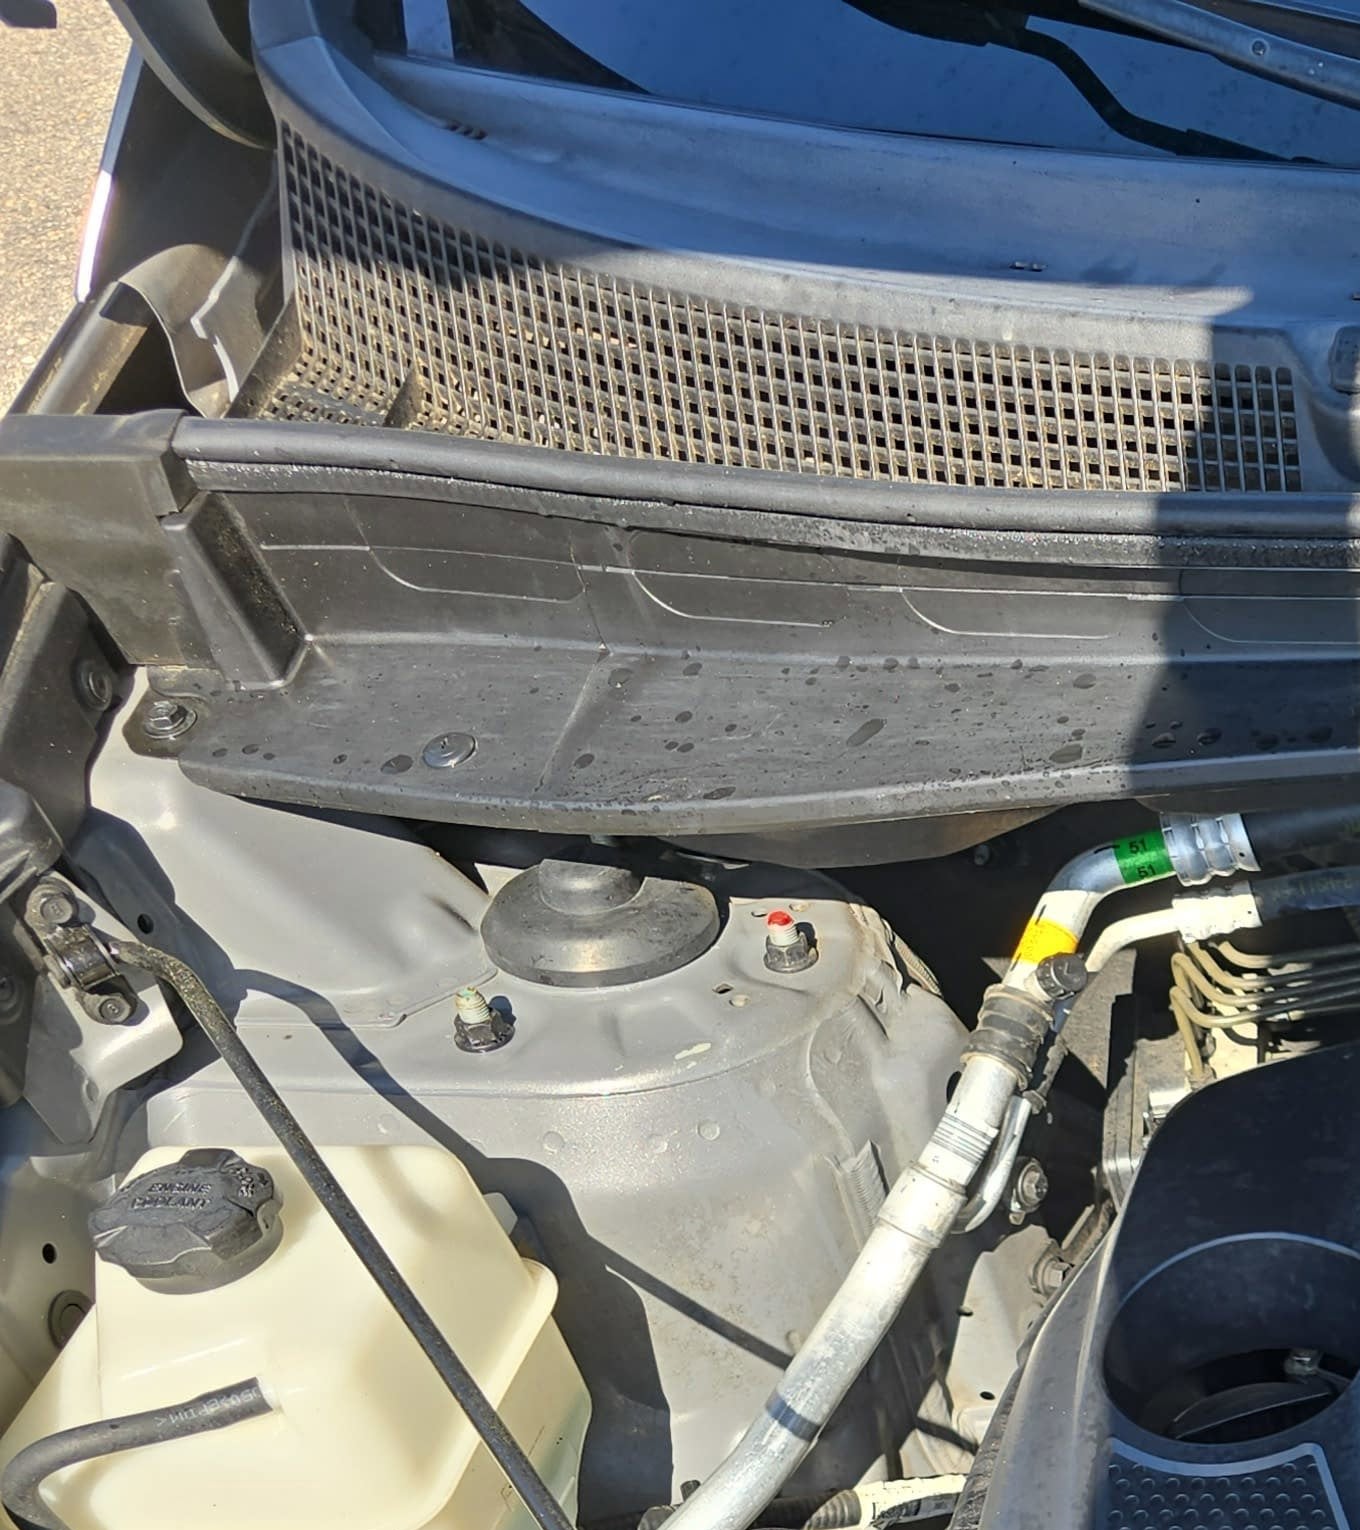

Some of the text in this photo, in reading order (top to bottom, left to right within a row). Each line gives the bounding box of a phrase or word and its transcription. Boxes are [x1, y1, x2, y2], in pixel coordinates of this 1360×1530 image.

[1128, 839, 1149, 855] 51
[1136, 864, 1157, 880] 51
[147, 1182, 211, 1196] ENGINE
